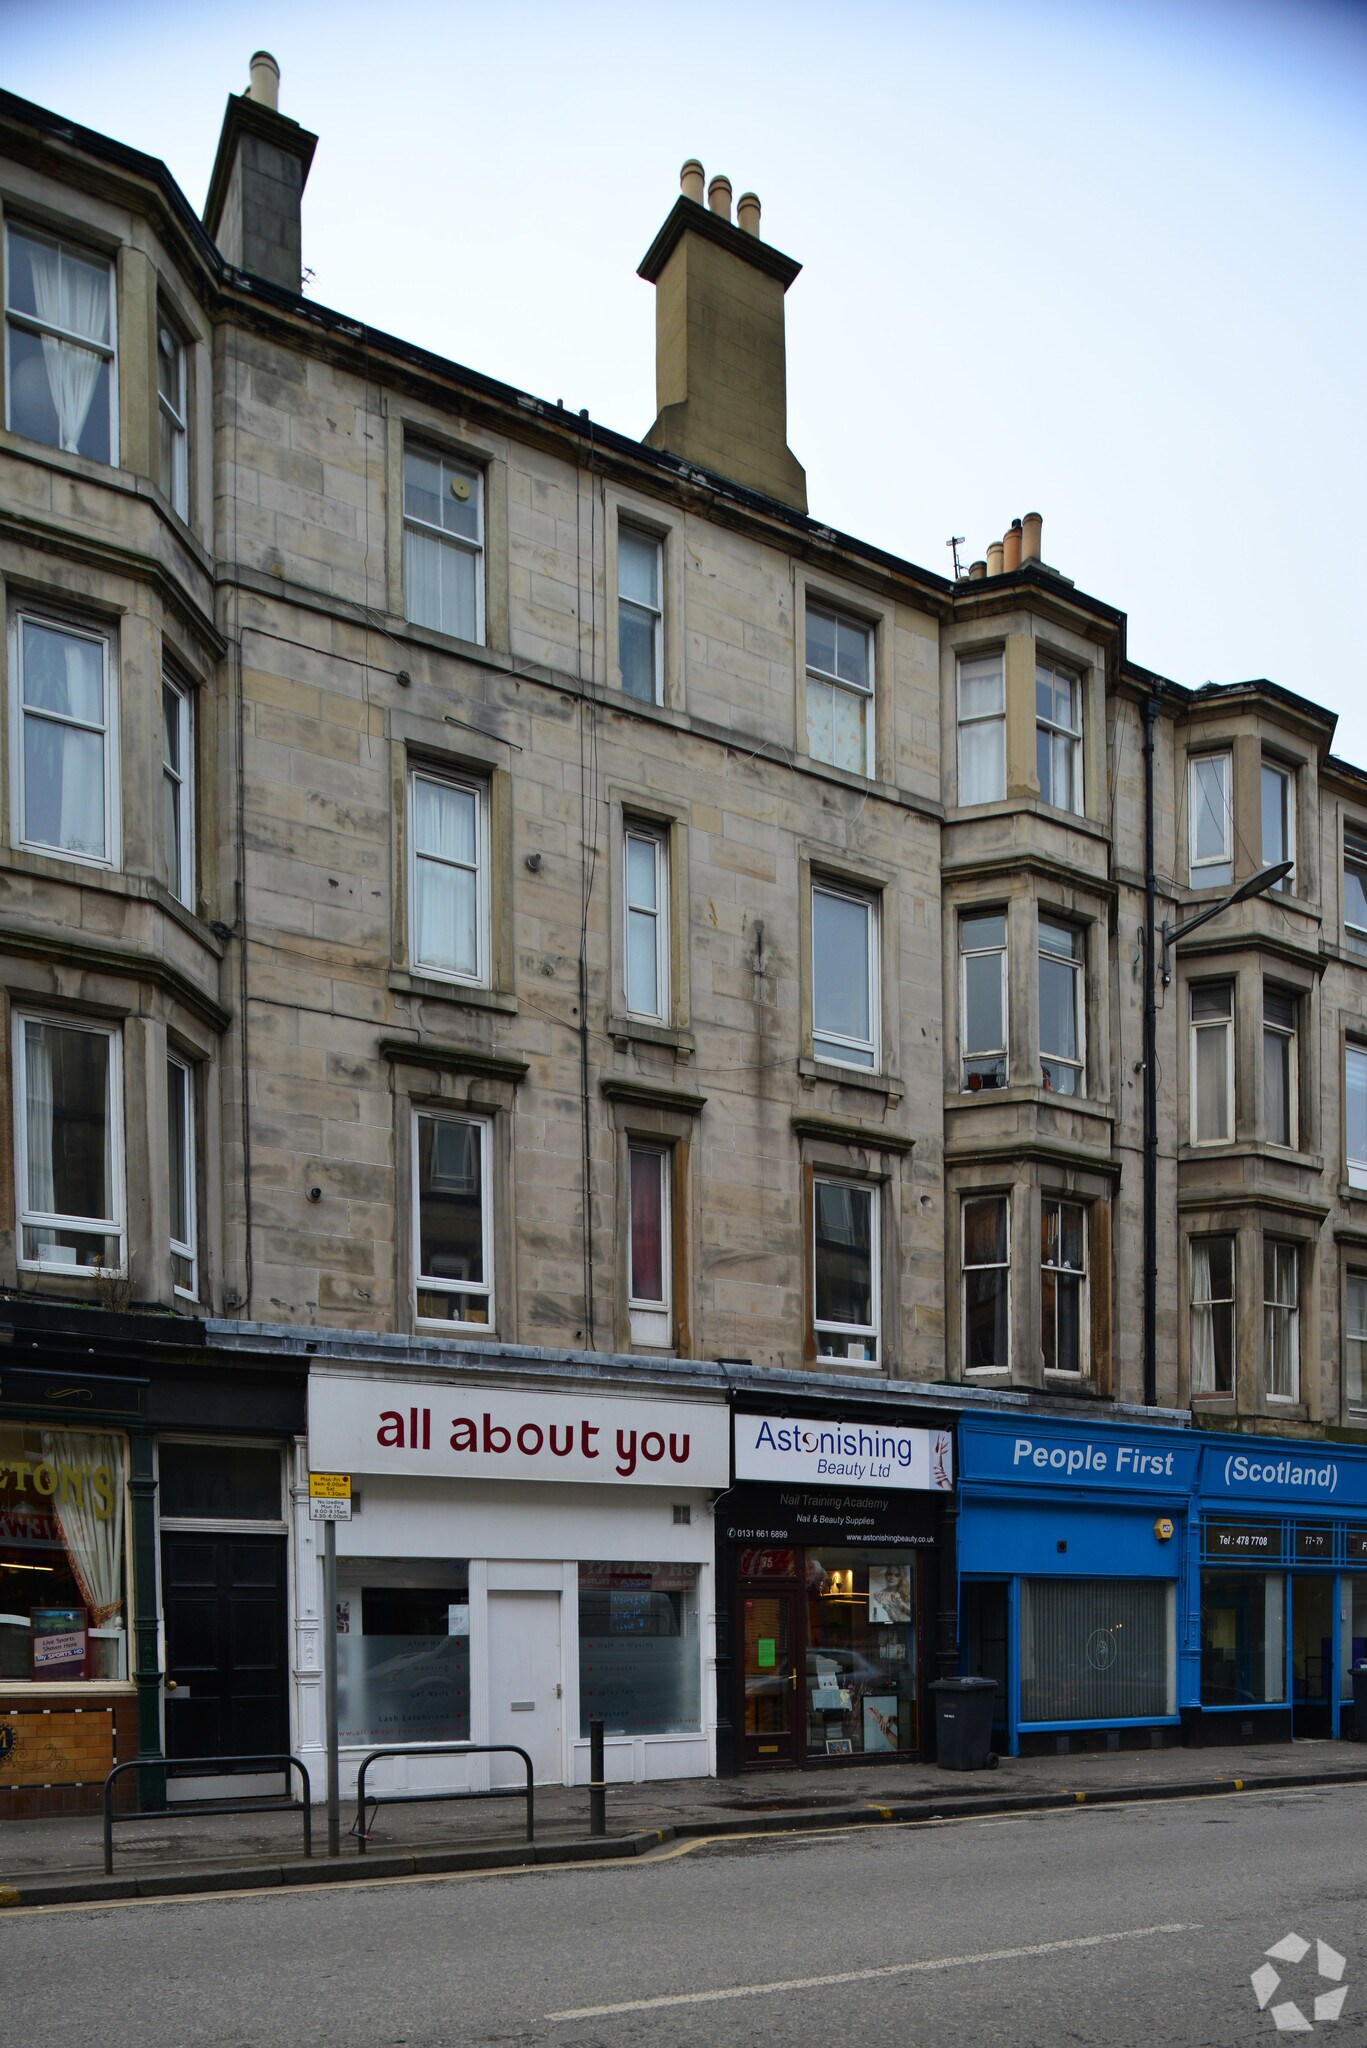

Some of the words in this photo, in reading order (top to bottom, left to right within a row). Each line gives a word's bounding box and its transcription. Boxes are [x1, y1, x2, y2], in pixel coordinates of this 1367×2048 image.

[376, 1407, 431, 1449] all
[449, 1413, 599, 1458] about
[615, 1429, 690, 1477] you
[755, 1421, 912, 1467] Astonishing
[1013, 1439, 1108, 1475] People
[1115, 1446, 1175, 1476] First
[817, 1459, 866, 1480] Beauty
[869, 1462, 891, 1478] Ltd
[1224, 1455, 1338, 1493] (Scotland)
[779, 1493, 801, 1505] Nail
[803, 1494, 842, 1510] Training
[842, 1496, 889, 1512] Academy
[796, 1513, 811, 1523] Nail
[812, 1514, 818, 1523] &
[819, 1514, 845, 1526] Beauty
[845, 1515, 875, 1527] Supplies
[737, 1529, 755, 1539] 0131
[756, 1529, 769, 1539] 661
[770, 1530, 788, 1540] 6899
[846, 1533, 935, 1545] www.astonishingbeauty.co.uk
[1219, 1535, 1231, 1545] Tel
[1236, 1535, 1249, 1546] 478
[1250, 1536, 1268, 1547] 7708
[1304, 1536, 1324, 1546] 77-79
[56, 1636, 75, 1644] Sports
[48, 1650, 73, 1659] SPORTS
[410, 1689, 425, 1698] Gel
[428, 1689, 449, 1698] Nails
[378, 1713, 400, 1723] Lash
[402, 1711, 450, 1722] Extensions
